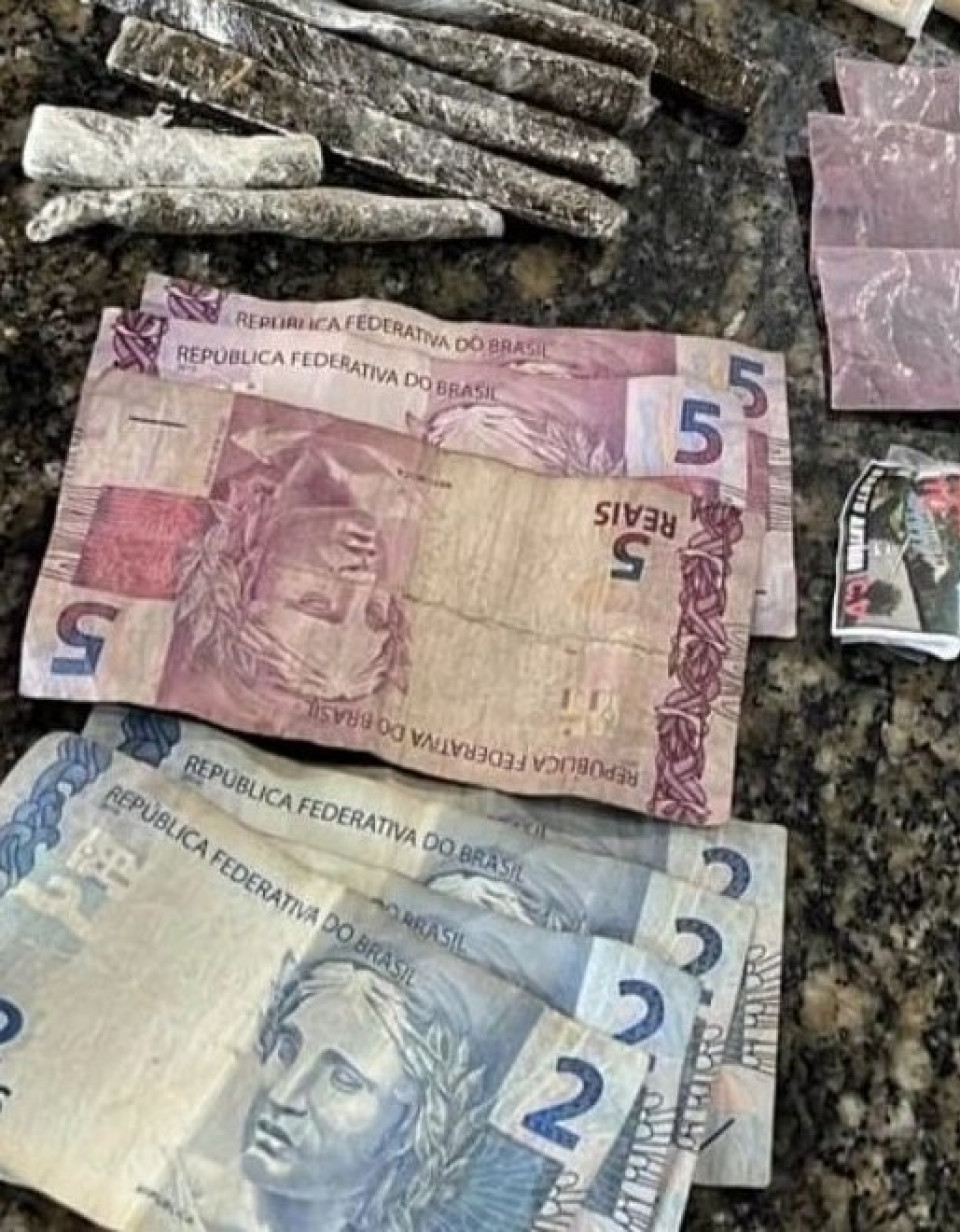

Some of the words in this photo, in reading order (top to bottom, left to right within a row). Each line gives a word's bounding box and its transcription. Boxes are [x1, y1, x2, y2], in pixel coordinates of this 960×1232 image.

[345, 313, 450, 350] FEDERATIVA
[455, 335, 484, 352] DO
[488, 337, 547, 359] BRASIL
[290, 350, 398, 386] FEDERATIVA
[404, 372, 432, 391] DO
[436, 379, 498, 402] BRASIL
[729, 355, 768, 419] 5
[675, 398, 723, 465] 5
[593, 500, 678, 540] REAIS
[610, 532, 650, 581] 5
[50, 601, 121, 676] 5
[307, 699, 374, 730] BRASIL
[377, 718, 406, 742] DO
[411, 727, 528, 772] FEDERATIVA
[297, 796, 417, 847] FEDERATIVA
[422, 831, 456, 857] DO
[458, 842, 525, 883] BRASIL
[210, 848, 320, 927] FEDERATIVA
[322, 912, 354, 943] DO
[353, 933, 417, 988] BRASIL
[522, 1056, 604, 1150] 2
